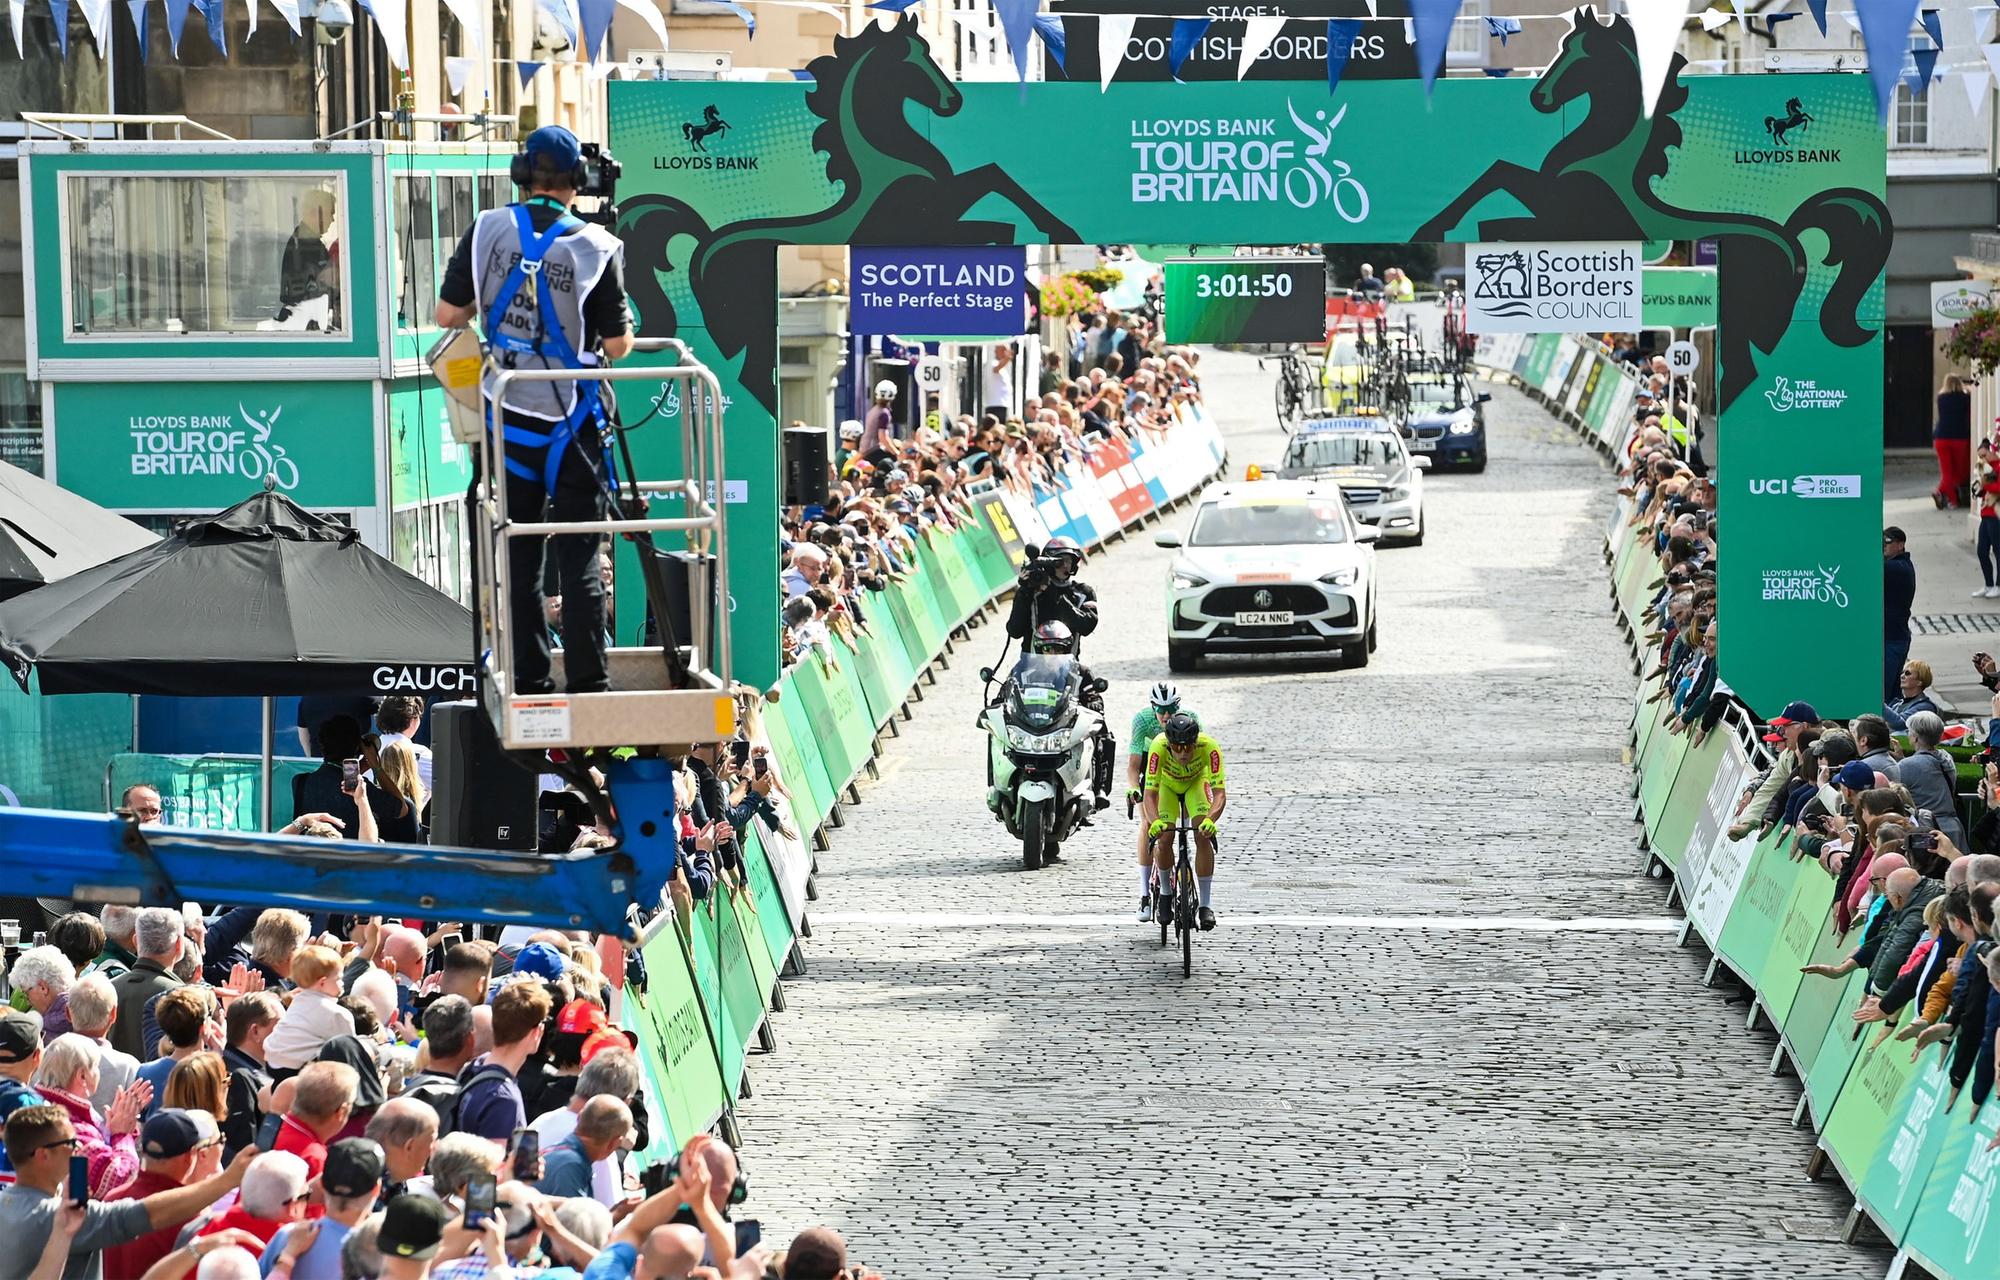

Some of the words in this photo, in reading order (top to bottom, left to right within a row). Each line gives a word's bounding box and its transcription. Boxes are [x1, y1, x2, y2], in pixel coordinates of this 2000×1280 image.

[1206, 6, 1267, 22] STAGE
[1131, 119, 1211, 137] LLOYDS
[1216, 119, 1276, 136] BANK
[653, 156, 712, 169] LLOYDS
[716, 157, 759, 169] BANK
[1131, 142, 1237, 171] TOUR
[1240, 141, 1295, 170] OF
[1734, 150, 1794, 164] LLOYDS
[1798, 149, 1841, 163] BANK
[1131, 172, 1278, 202] BRITAIN
[1536, 250, 1634, 272] Scottish
[861, 264, 1015, 287] SCOTLAND
[1196, 273, 1292, 298] 3:01:50
[1537, 275, 1634, 297] Borders
[861, 293, 893, 307] The
[898, 292, 961, 308] Perfect
[965, 293, 1014, 311] Stage
[1641, 295, 1675, 306] OYDS
[1678, 295, 1712, 306] BANK
[1536, 301, 1634, 319] COUNCIL
[1673, 350, 1691, 365] 50
[923, 366, 941, 382] 50
[1795, 380, 1816, 389] THE
[1794, 389, 1848, 399] NATIONAL
[1794, 400, 1842, 409] LOTTERY
[130, 416, 187, 429] LLOYDS
[190, 416, 232, 428] BANK
[130, 431, 206, 453] TOUR
[207, 431, 246, 453] OF
[131, 453, 235, 475] BRITAIN
[1749, 479, 1788, 495] UCI
[1819, 479, 1838, 487] PRO
[1819, 486, 1849, 494] SERIES
[1793, 569, 1815, 577] BANK
[1762, 577, 1799, 589] TOUR
[1798, 577, 1822, 589] OF
[1254, 590, 1272, 608] MG
[1762, 588, 1816, 601] BRITAIN
[1239, 613, 1266, 624] LC24
[1269, 613, 1290, 623] NNG
[372, 665, 477, 691] GAUCH
